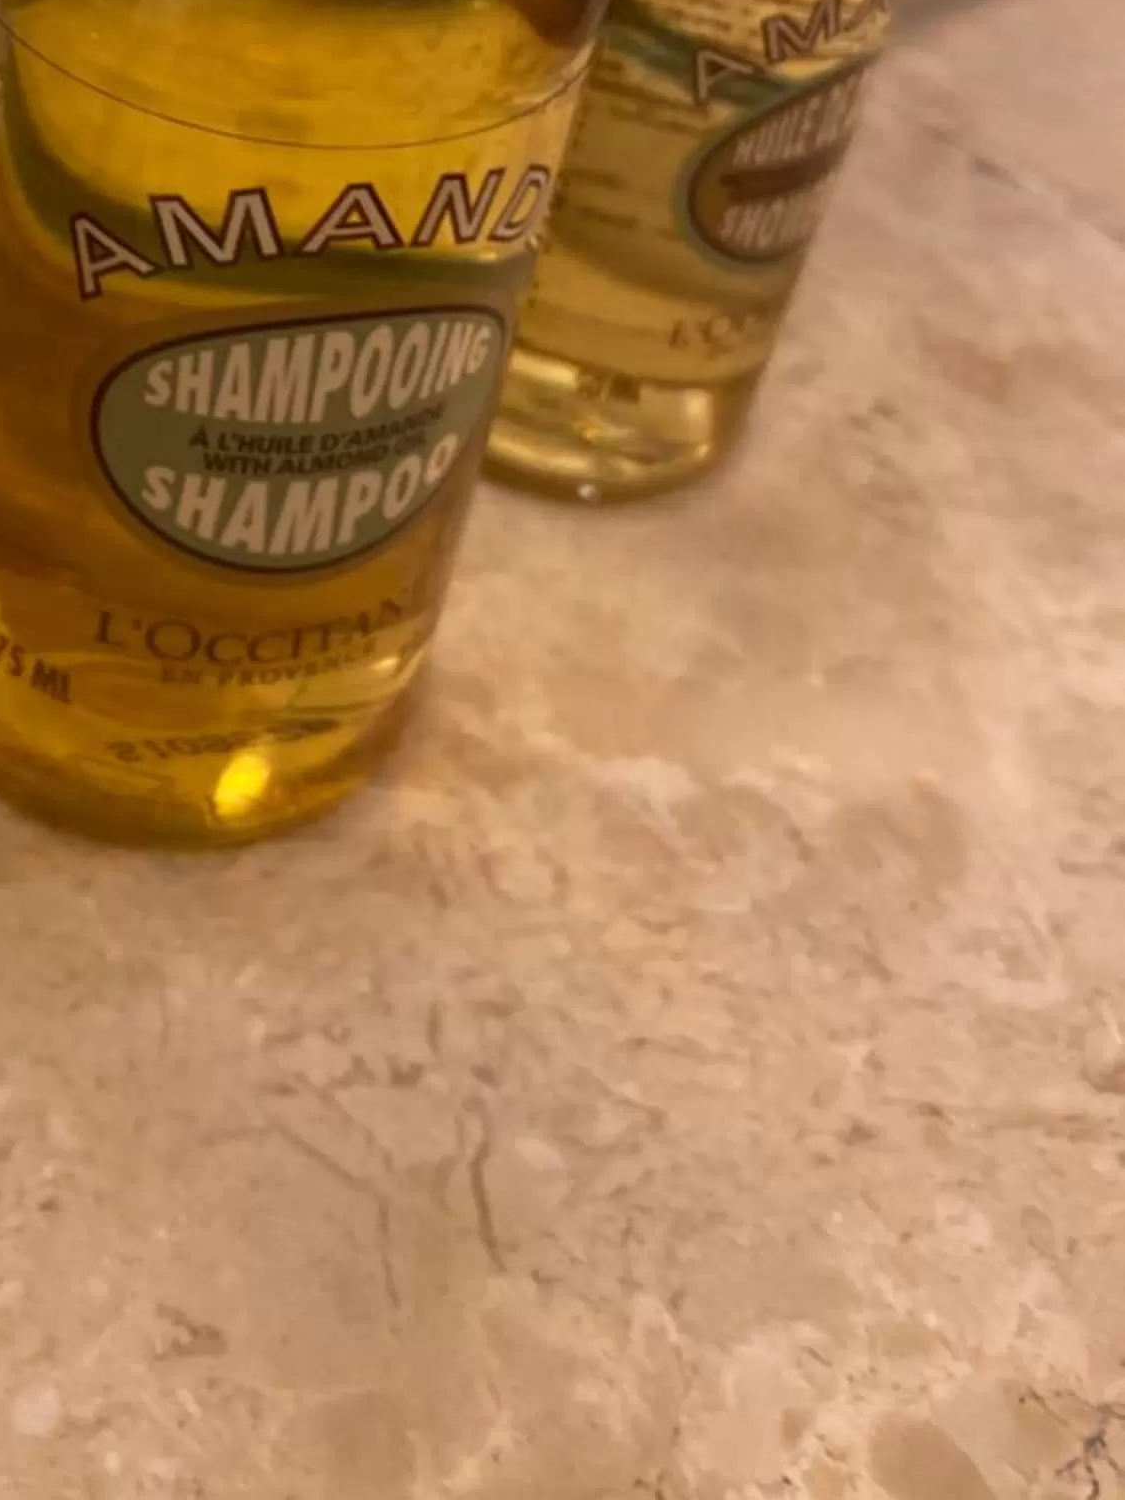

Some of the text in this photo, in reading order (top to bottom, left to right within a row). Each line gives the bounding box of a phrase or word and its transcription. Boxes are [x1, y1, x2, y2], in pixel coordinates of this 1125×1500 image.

[69, 162, 552, 301] AMAND
[143, 321, 492, 424] SHAMPOOING
[202, 451, 273, 475] WITH
[278, 443, 389, 475] ALMOND
[217, 431, 315, 454] L'HUILE
[141, 432, 460, 556] SHAMPOO
[29, 657, 72, 705] ML
